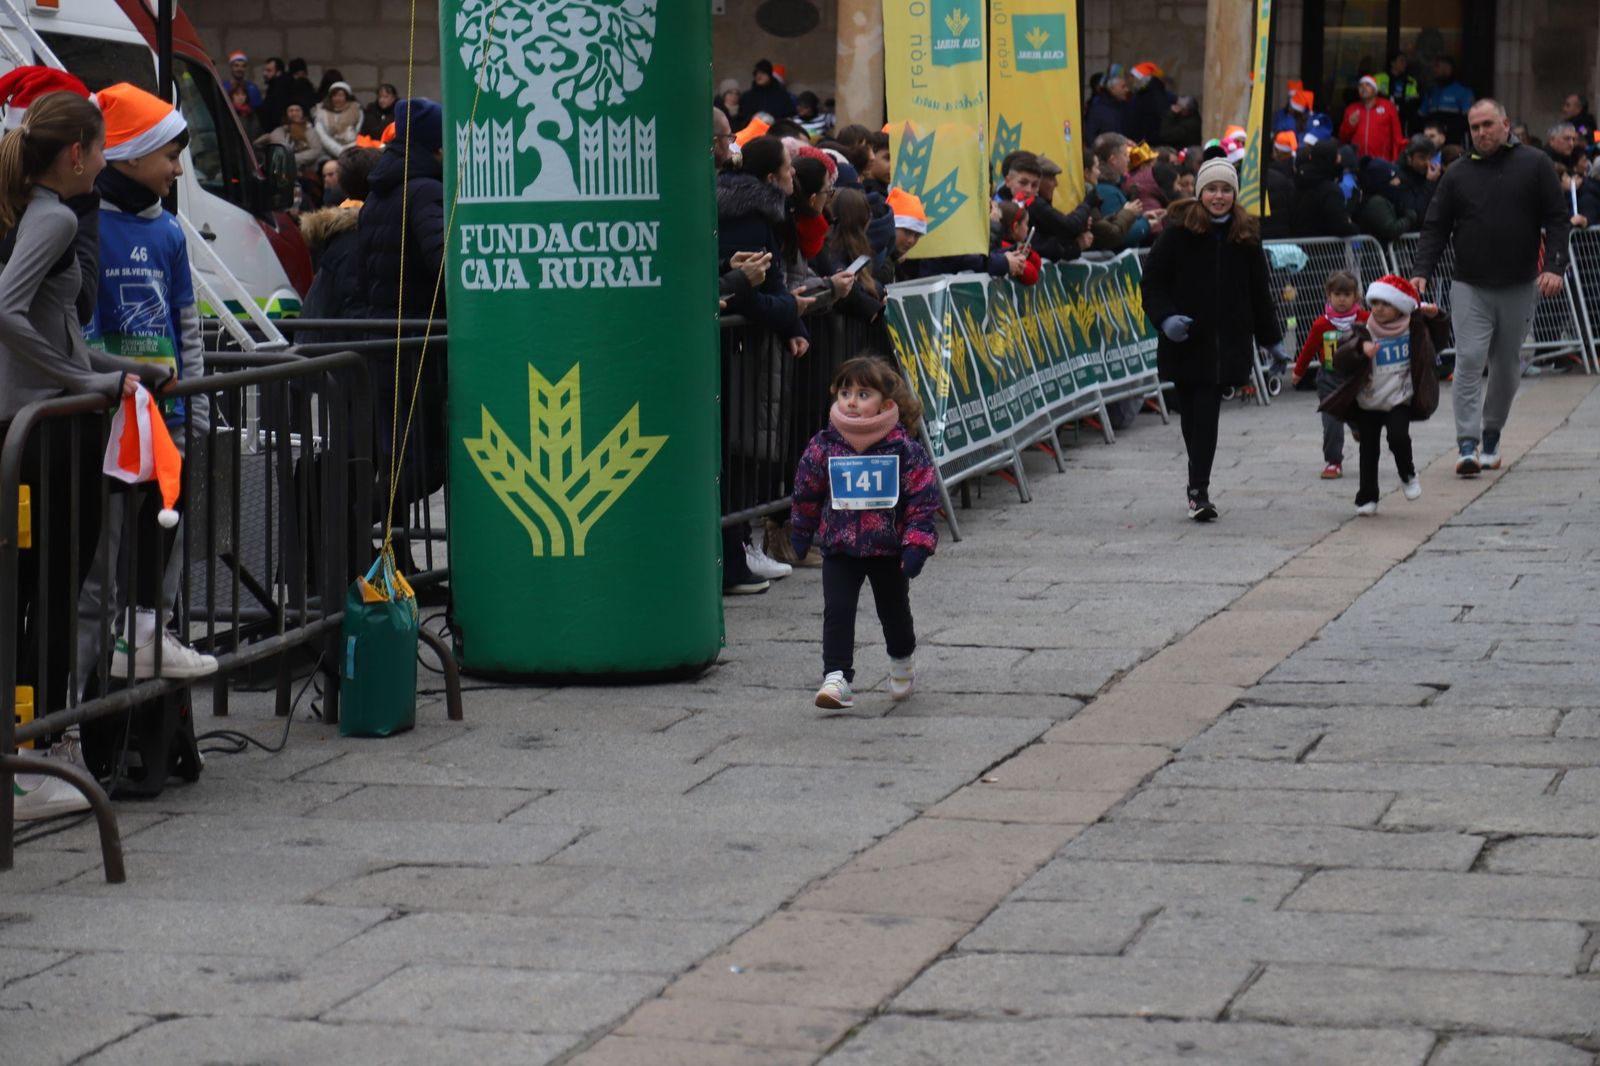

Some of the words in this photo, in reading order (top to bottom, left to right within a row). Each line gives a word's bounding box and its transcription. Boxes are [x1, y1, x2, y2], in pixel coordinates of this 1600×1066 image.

[460, 221, 660, 255] FUNDACION
[130, 246, 148, 262] 46
[460, 257, 530, 292] CAJA
[538, 256, 662, 289] RURAL
[1383, 343, 1410, 361] 118
[841, 470, 882, 492] 141
